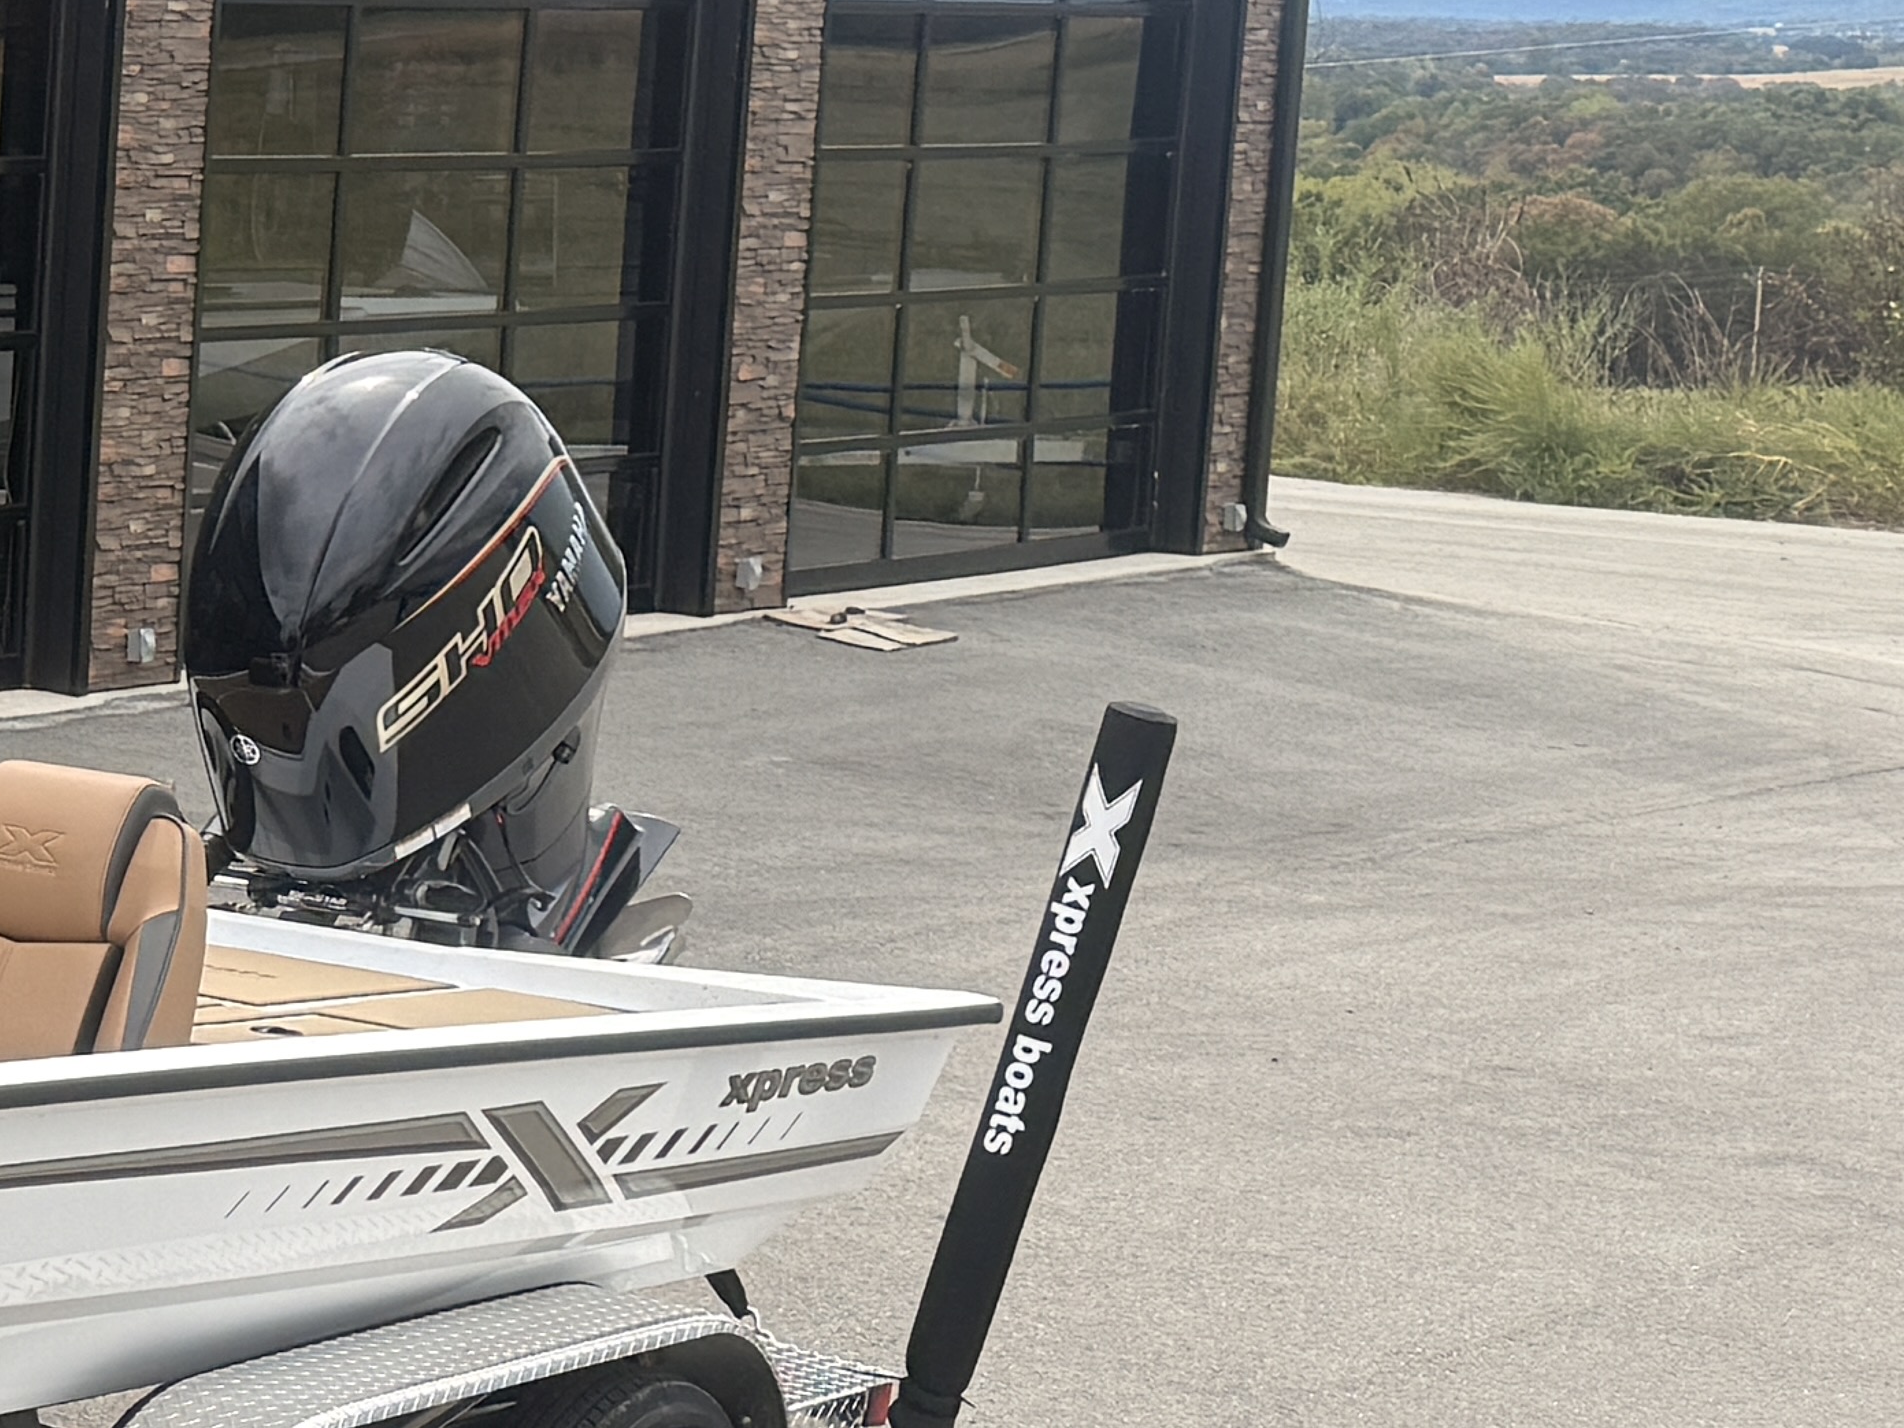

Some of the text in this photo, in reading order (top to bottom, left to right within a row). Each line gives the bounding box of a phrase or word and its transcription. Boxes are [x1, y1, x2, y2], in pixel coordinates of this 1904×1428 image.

[376, 524, 546, 754] SHO
[1019, 875, 1096, 1028] xpress
[719, 1053, 877, 1115] xpress
[982, 1031, 1054, 1158] boats
